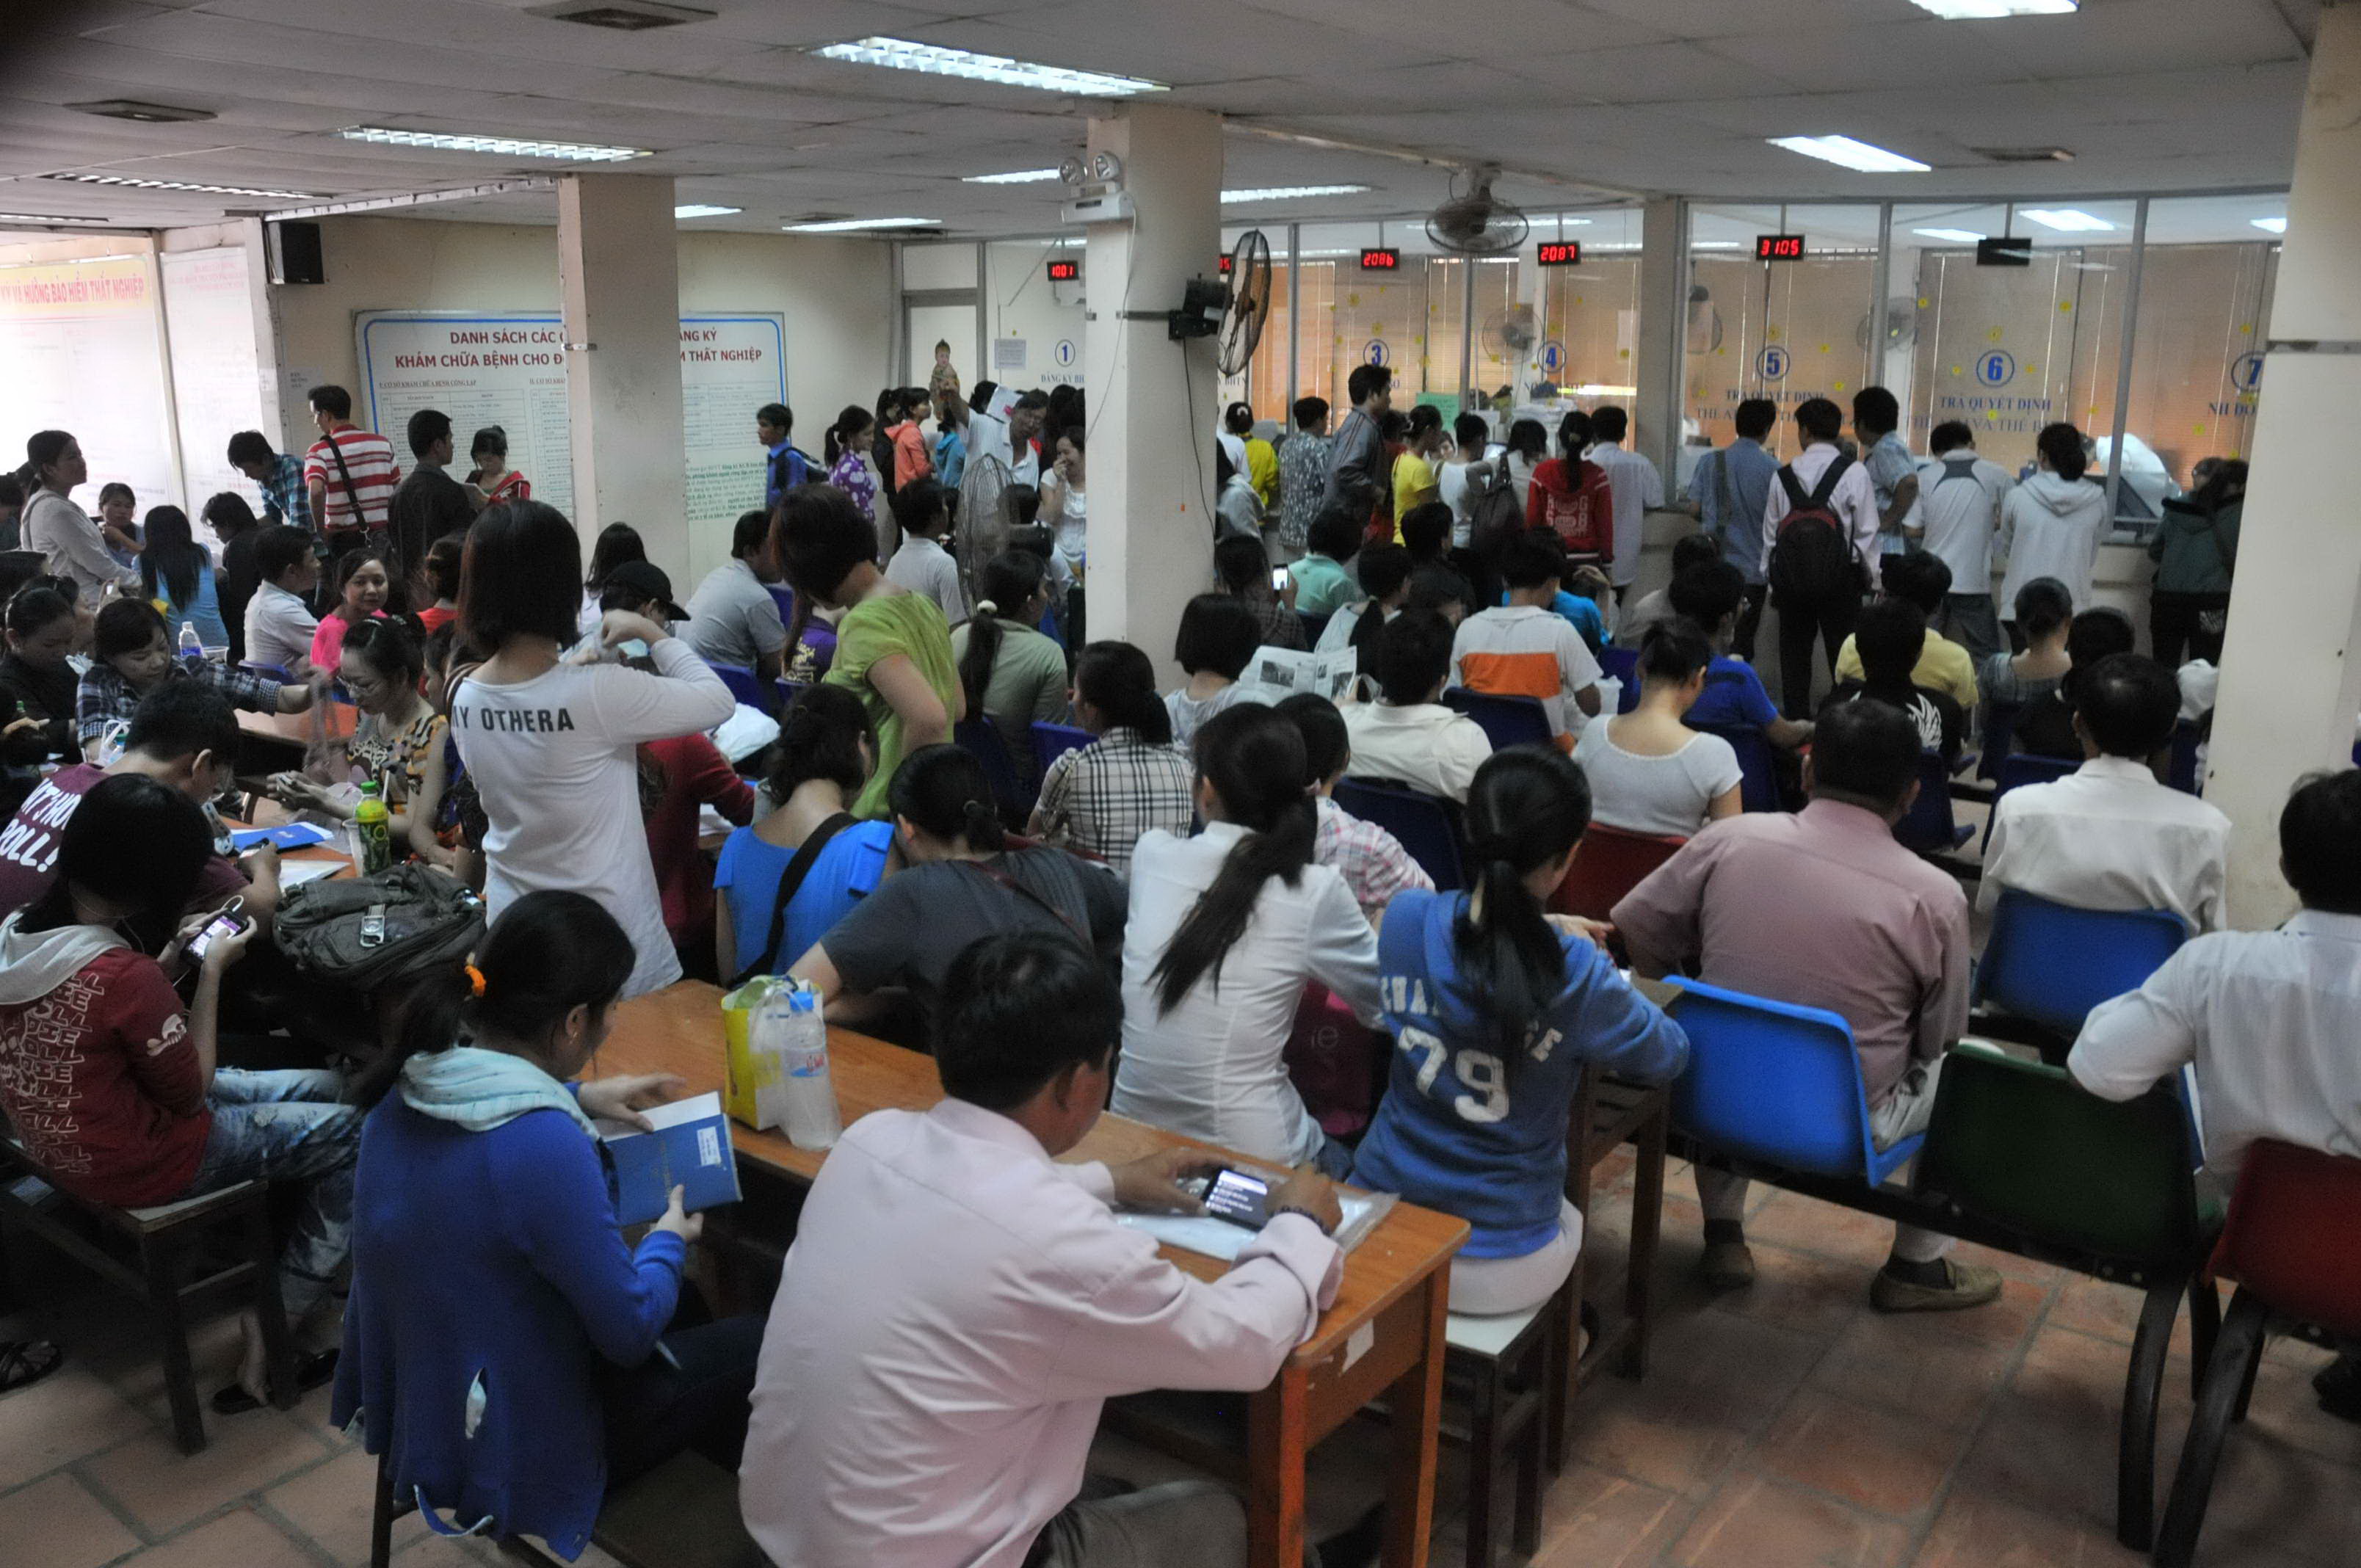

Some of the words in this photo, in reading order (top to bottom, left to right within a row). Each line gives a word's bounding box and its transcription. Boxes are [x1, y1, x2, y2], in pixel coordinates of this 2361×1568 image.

[1540, 244, 1575, 262] 2087
[1761, 239, 1799, 256] 3105
[1363, 253, 1393, 267] 2086
[450, 331, 489, 344] DANH
[493, 328, 528, 344] SÁCH
[531, 328, 556, 343] CÁC
[395, 352, 437, 369] KHÁM
[440, 351, 479, 368] CHỮA
[483, 350, 519, 369] BỆNH
[523, 353, 550, 366] CHO
[721, 346, 762, 363] NGHIỆP
[1062, 344, 1068, 362] 1
[1371, 344, 1382, 366] 3
[1545, 346, 1556, 369] 4
[1766, 352, 1780, 375] 5
[1987, 356, 2003, 381] 6
[2249, 358, 2263, 384] 7
[1398, 1026, 1509, 1123] 79
